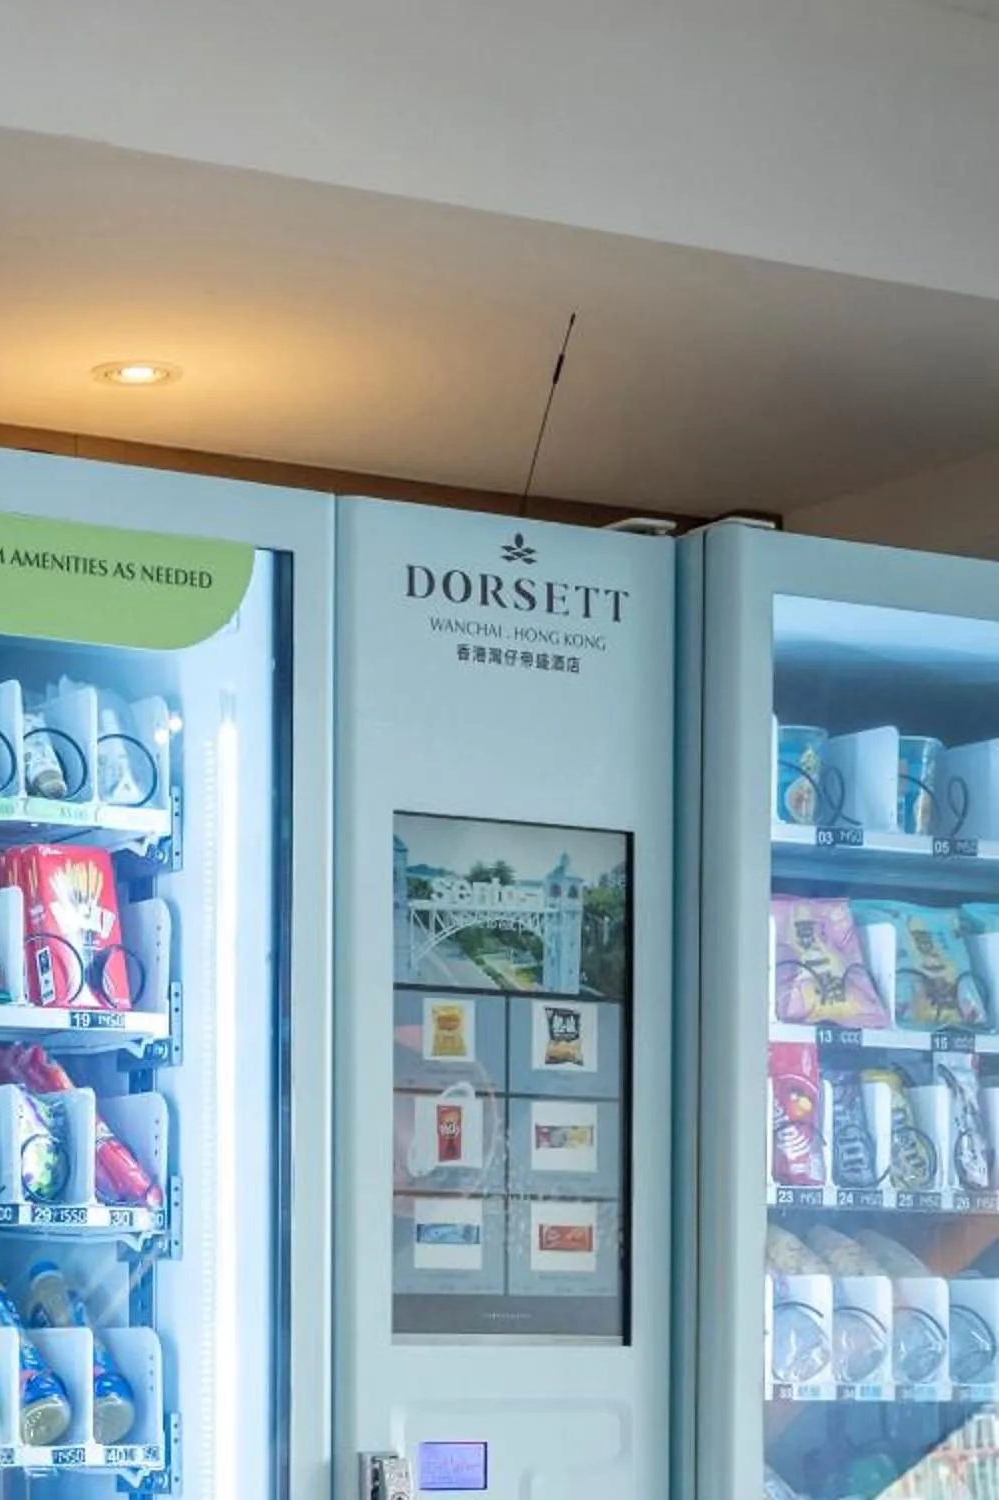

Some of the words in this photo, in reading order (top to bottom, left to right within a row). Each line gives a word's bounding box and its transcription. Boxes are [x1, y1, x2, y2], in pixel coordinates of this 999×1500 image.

[10, 549, 108, 577] AMENITIES
[113, 561, 136, 580] AS
[140, 565, 213, 589] NEEDED
[405, 564, 629, 622] DORSETT
[514, 625, 560, 646] HONG
[564, 631, 606, 651] KONG
[73, 1013, 90, 1027] 19
[34, 1208, 51, 1223] 29
